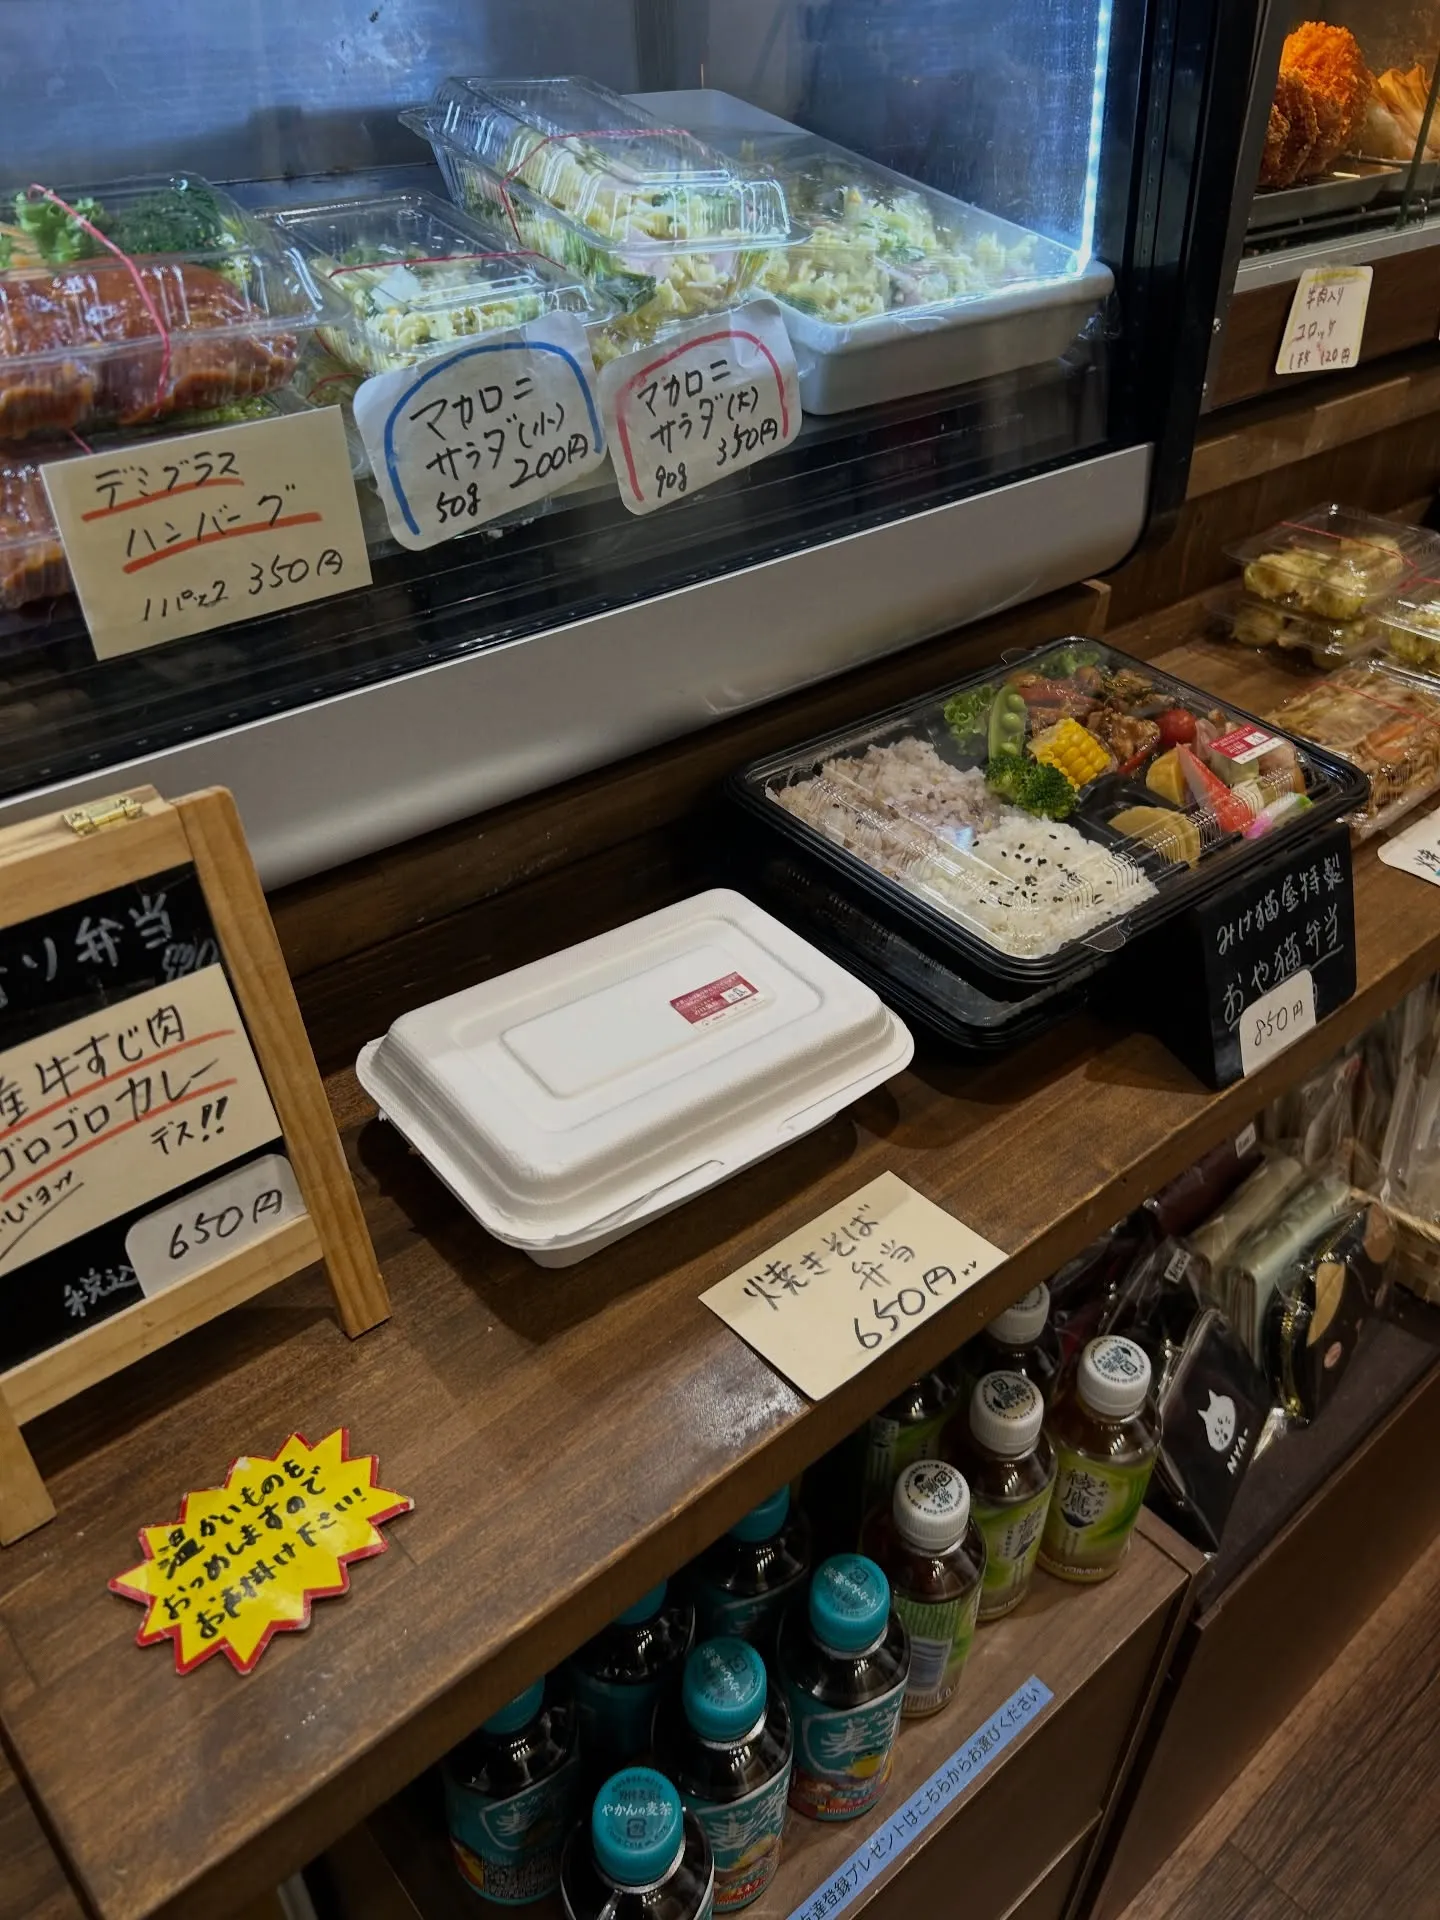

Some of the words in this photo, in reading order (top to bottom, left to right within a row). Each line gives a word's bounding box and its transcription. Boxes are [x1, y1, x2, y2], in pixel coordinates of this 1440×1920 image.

[410, 376, 535, 441] マカロニ
[637, 359, 731, 417] マカロニ
[95, 451, 240, 509] デミグラス
[436, 486, 482, 524] 50g
[509, 432, 590, 490] 200円
[656, 464, 688, 498] 90g
[716, 417, 779, 466] 350円
[126, 484, 296, 557] ハンバーグ
[248, 548, 344, 596] 350円
[0, 892, 172, 982] り弁当
[1216, 852, 1345, 956] みけ猫屋特製
[1222, 902, 1339, 1025] おや猫弁当
[1254, 999, 1304, 1047] 850円
[0, 1058, 219, 1178] ゴロゴロカレー
[167, 1188, 283, 1260] 650円
[742, 1203, 880, 1312] 焼きそば
[851, 1239, 916, 1291] 弁当
[157, 1458, 305, 1580] 温かいものを
[600, 1800, 674, 1818] やかんの麦茶
